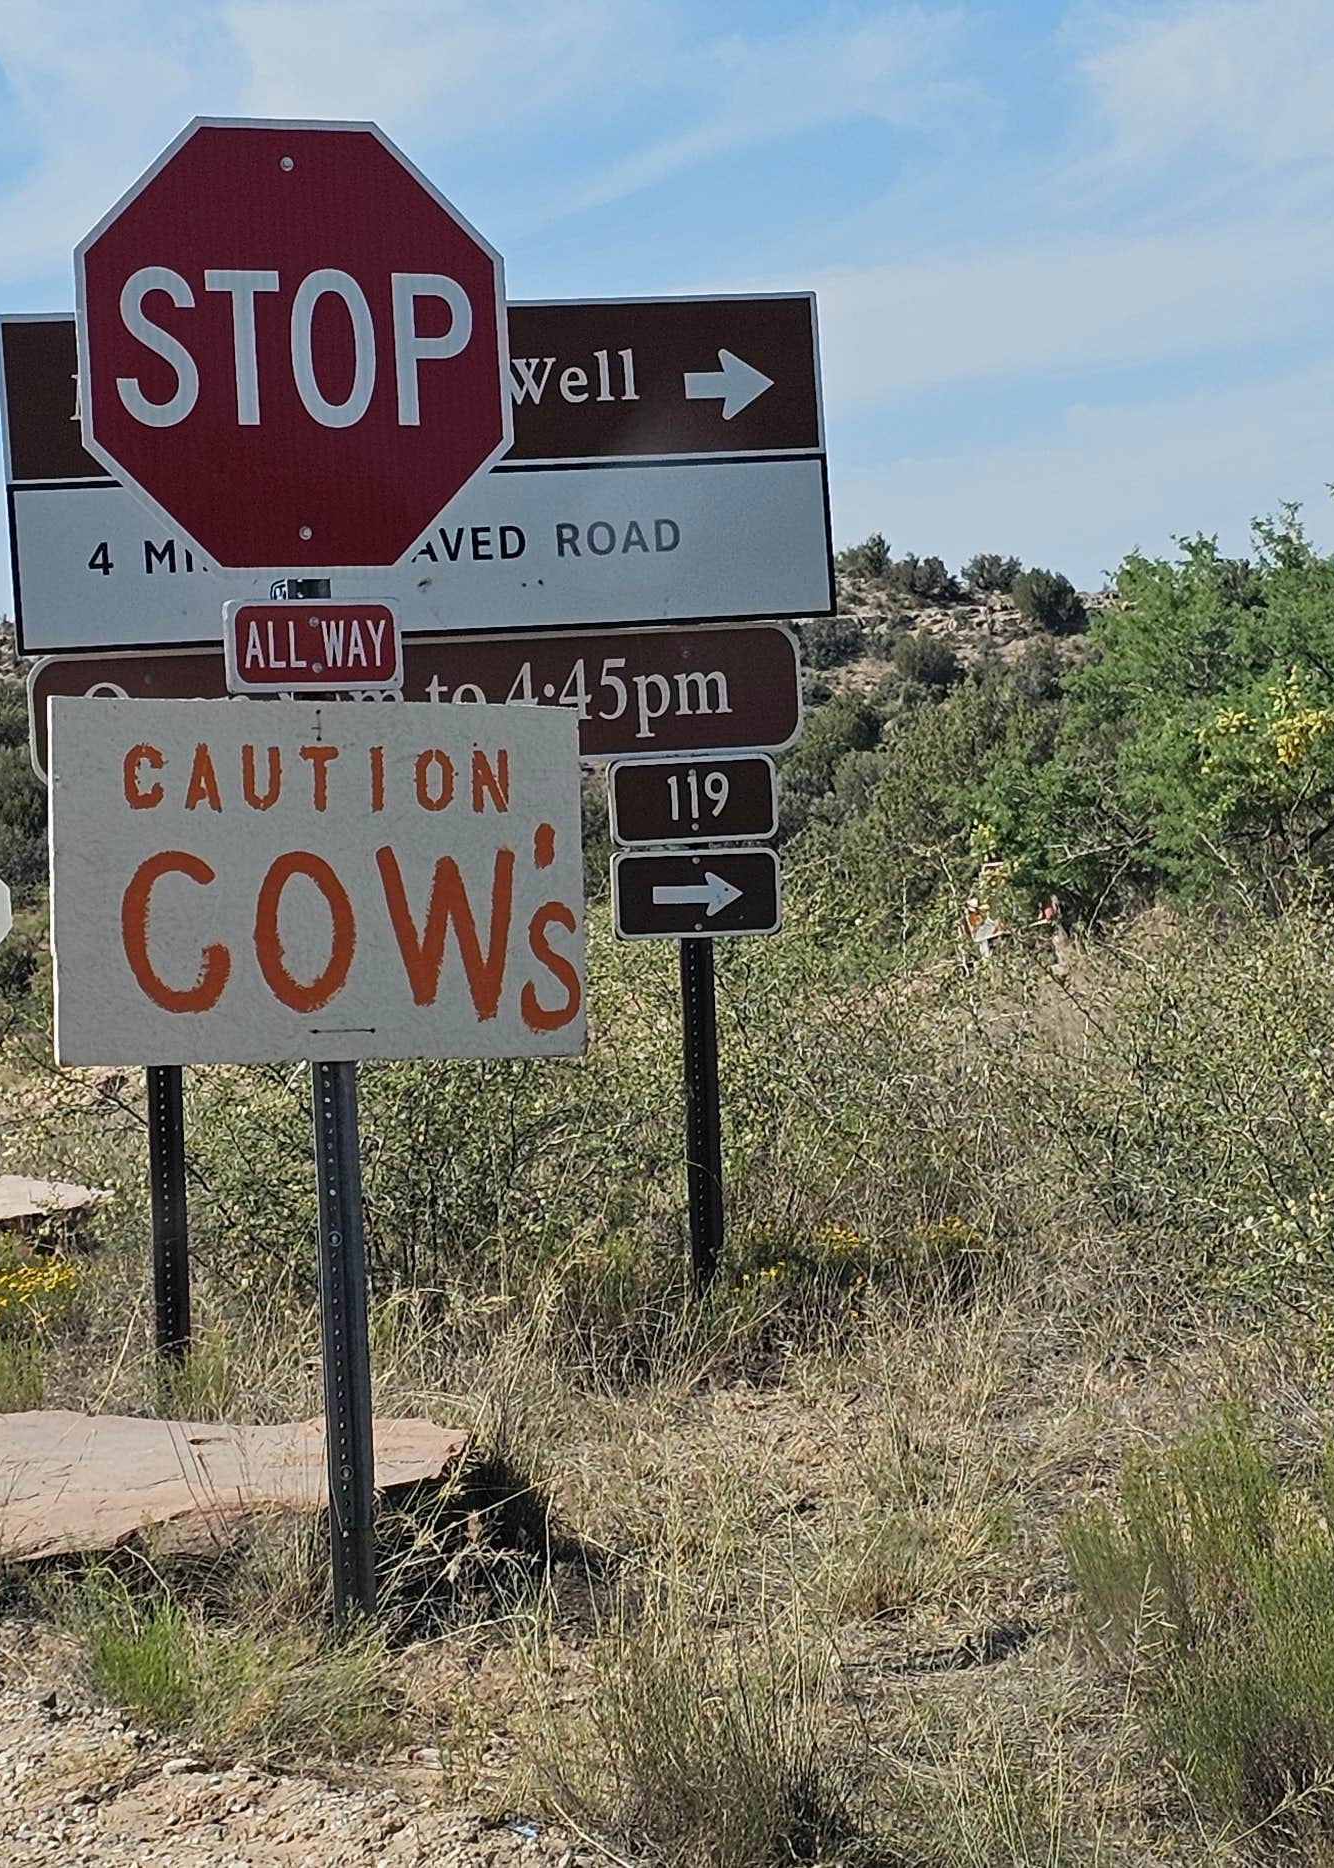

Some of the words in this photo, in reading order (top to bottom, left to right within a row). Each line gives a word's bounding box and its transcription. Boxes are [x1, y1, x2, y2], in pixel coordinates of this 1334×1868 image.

[115, 265, 474, 428] STOP
[511, 348, 640, 406] Well
[88, 541, 114, 576] 4
[555, 518, 681, 558] ROAD
[245, 620, 307, 669] ALL
[321, 619, 386, 667] WAY
[121, 741, 511, 814] CAUTION
[667, 770, 729, 821] 119
